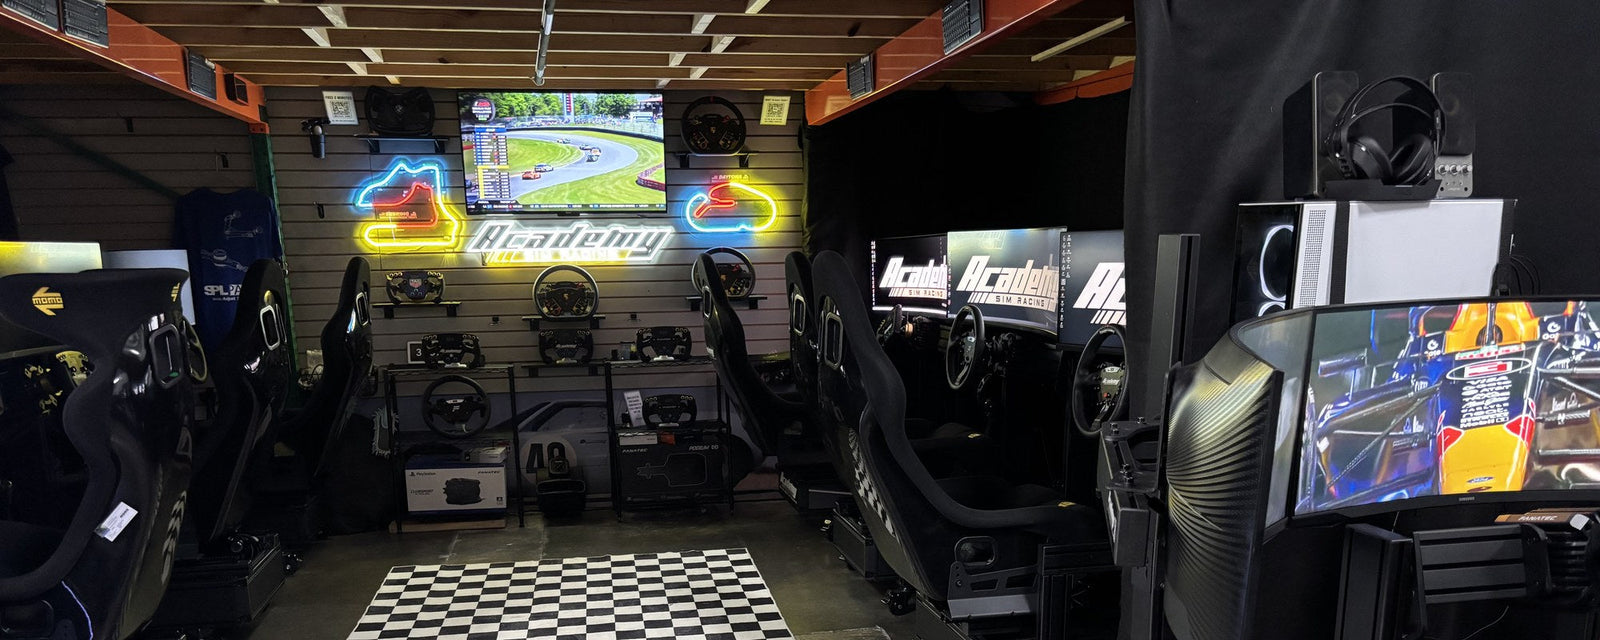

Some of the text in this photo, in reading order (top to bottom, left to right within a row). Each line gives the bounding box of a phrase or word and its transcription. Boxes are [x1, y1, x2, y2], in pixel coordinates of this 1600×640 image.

[466, 219, 674, 263] Academy
[203, 284, 229, 296] SPL
[995, 295, 1045, 308] SIM RACING
[416, 348, 422, 356] 3
[1465, 376, 1508, 386] VISA
